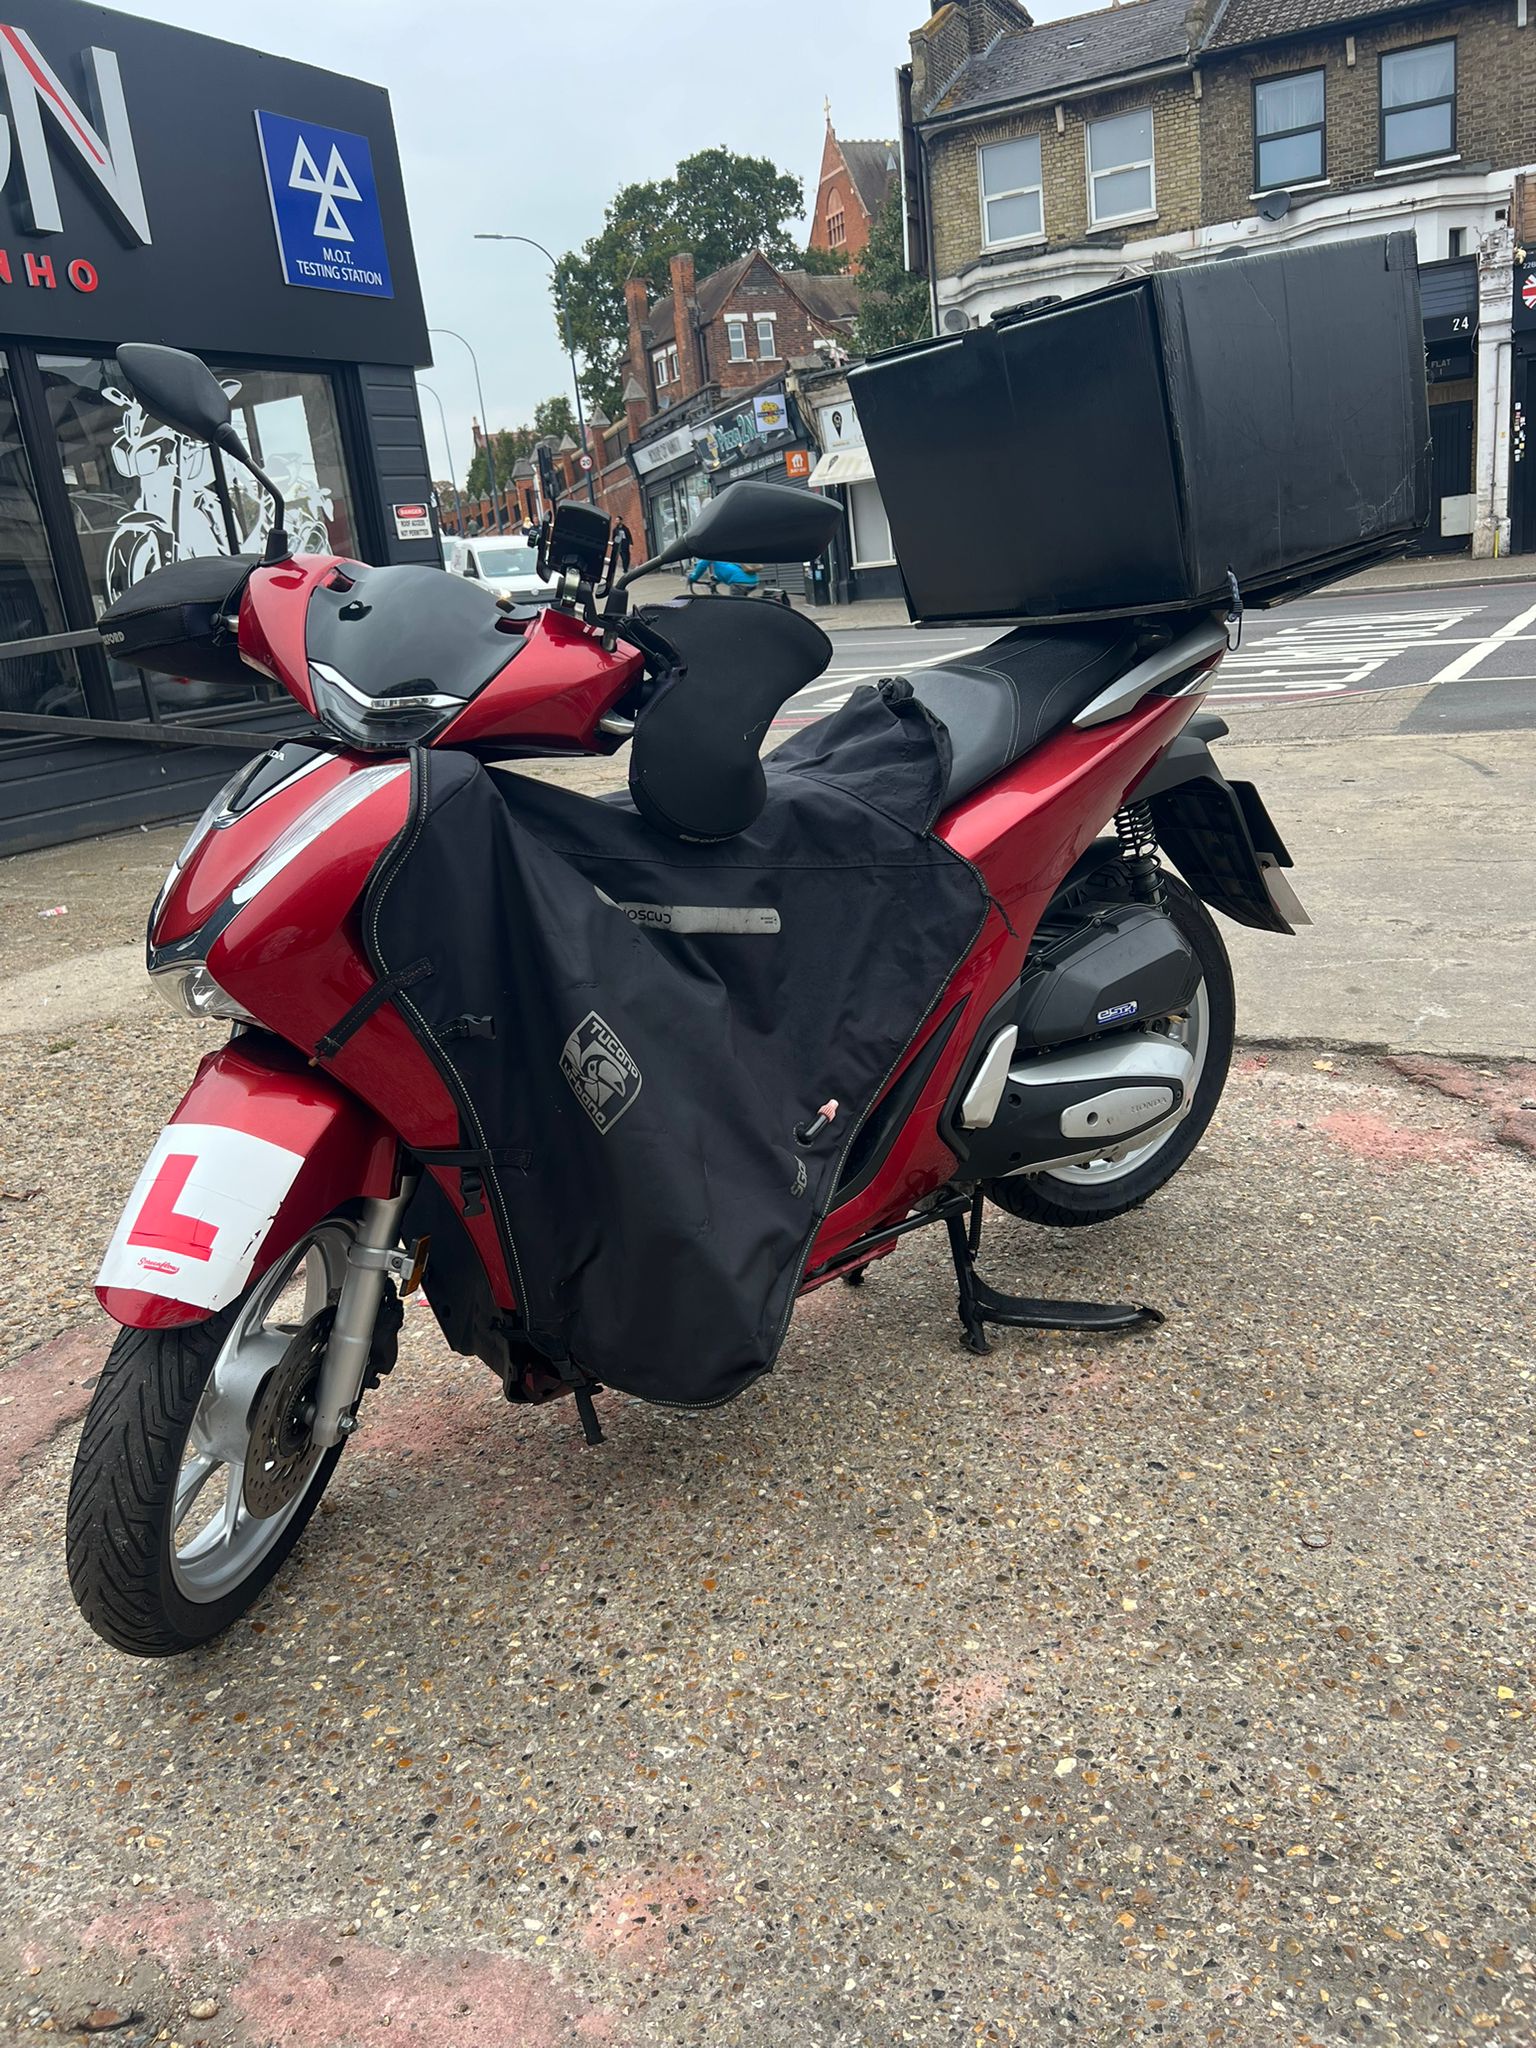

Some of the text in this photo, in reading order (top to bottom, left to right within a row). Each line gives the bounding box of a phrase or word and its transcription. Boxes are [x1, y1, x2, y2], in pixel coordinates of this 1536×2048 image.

[323, 247, 354, 265] M.O.T.
[296, 260, 383, 286] TESTING STATION
[1453, 316, 1469, 331] 24
[1431, 359, 1451, 368] FLAT
[127, 1154, 219, 1262] L
